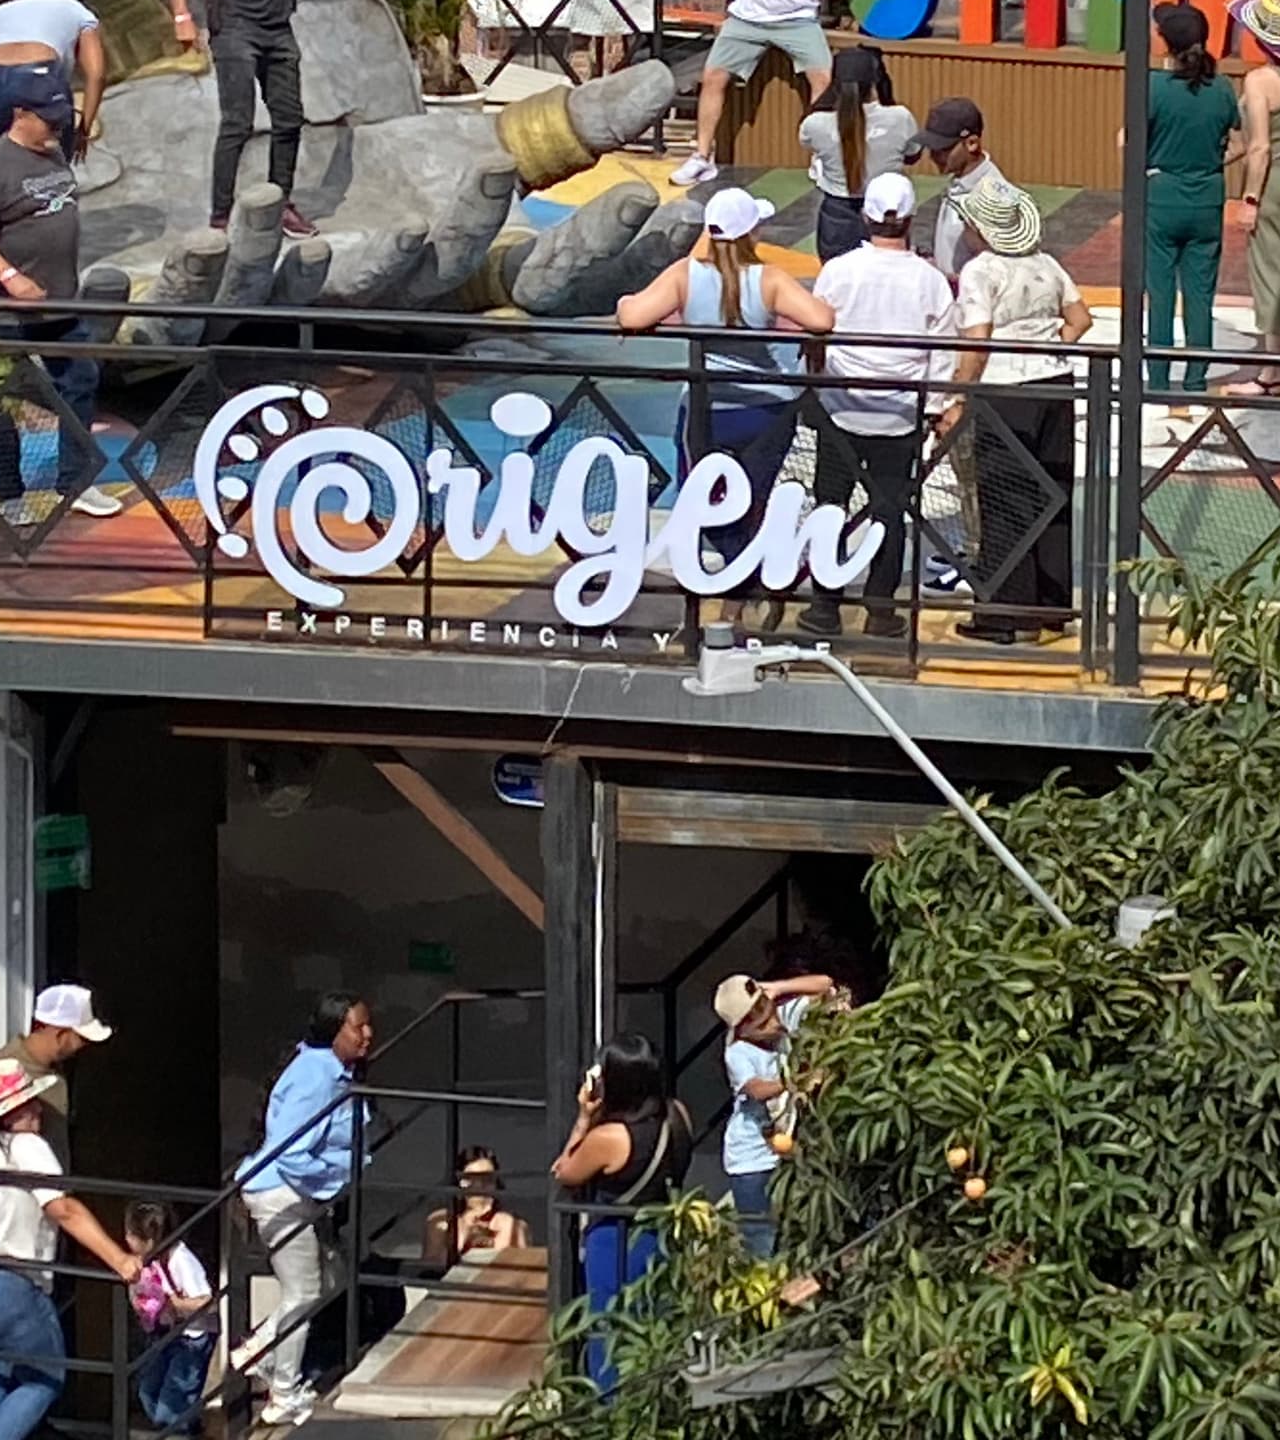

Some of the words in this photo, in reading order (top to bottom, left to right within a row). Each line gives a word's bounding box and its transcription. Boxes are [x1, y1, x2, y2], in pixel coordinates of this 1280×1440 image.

[194, 383, 887, 627] Origen
[266, 610, 619, 650] EXPERIENCIA
[652, 632, 671, 653] Y
